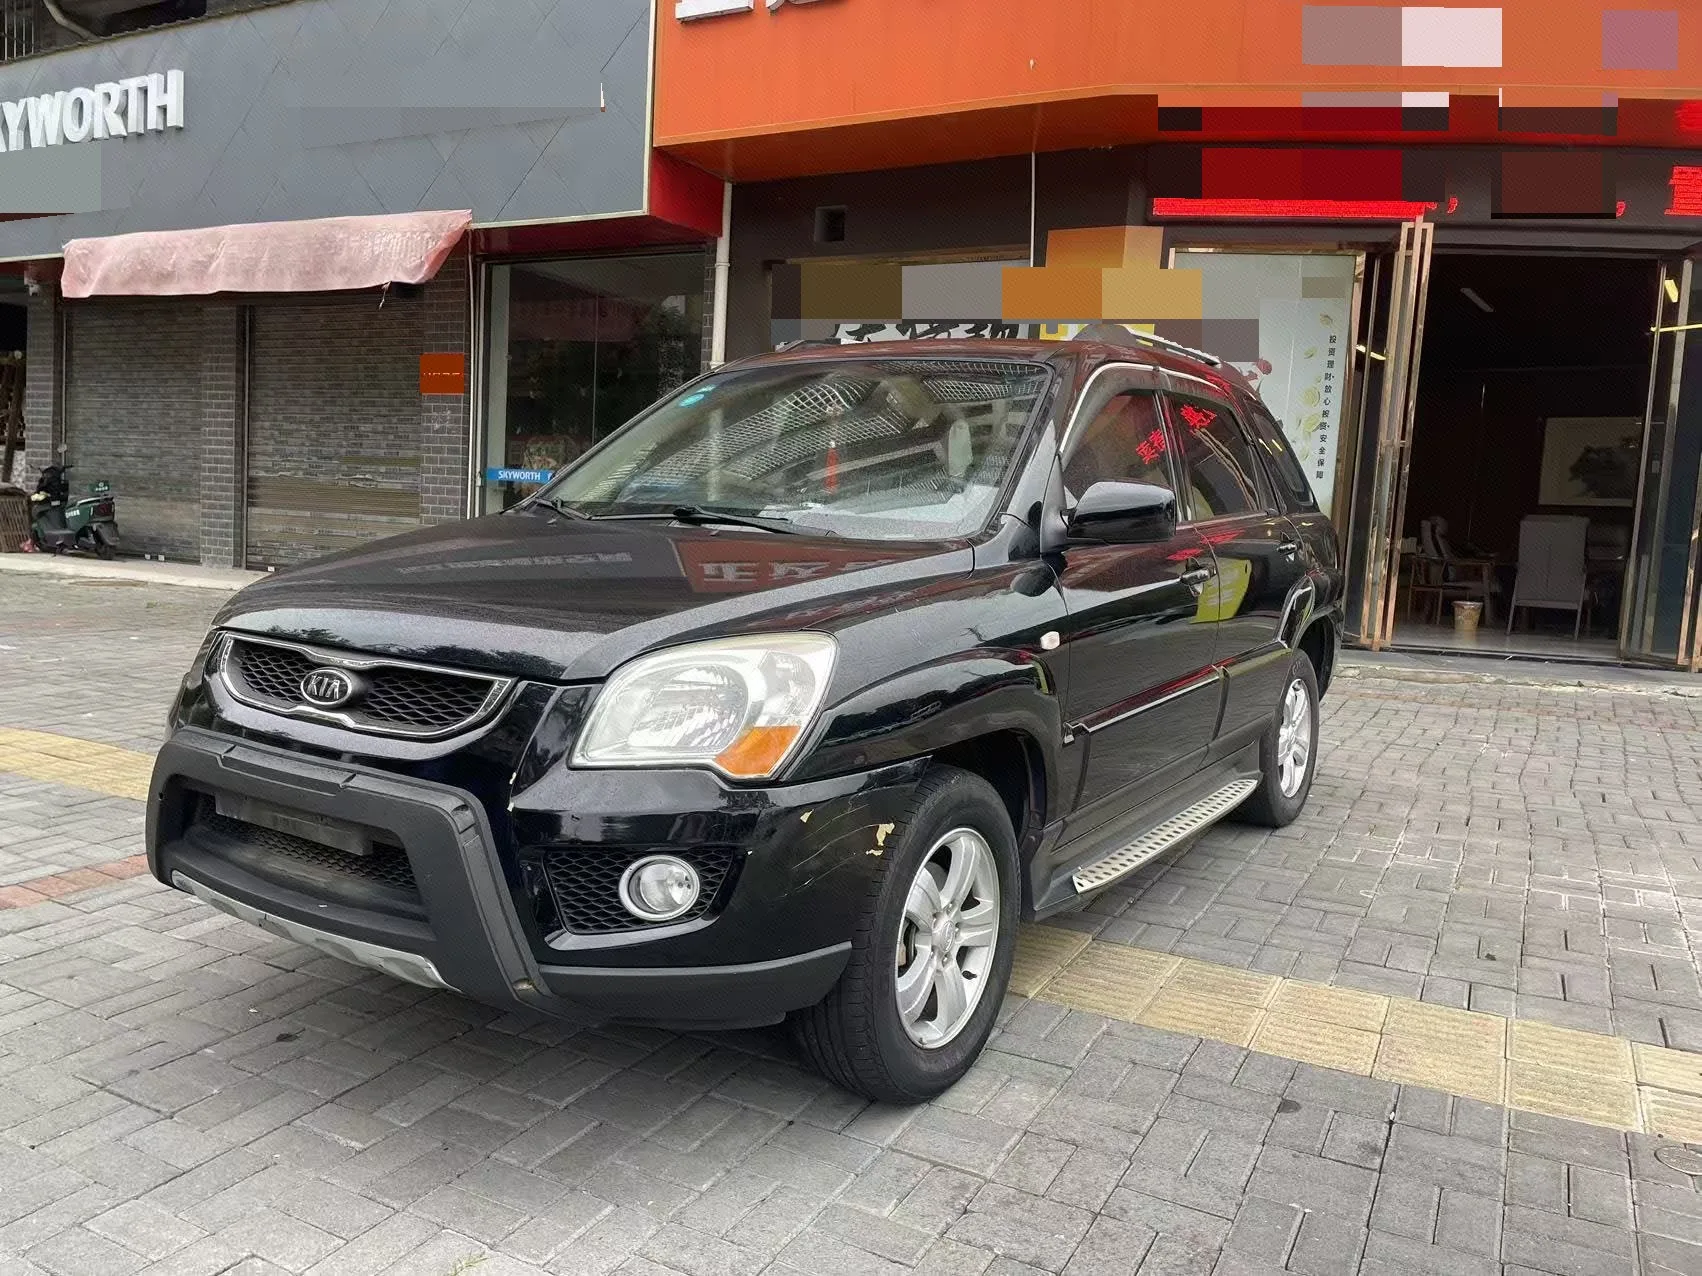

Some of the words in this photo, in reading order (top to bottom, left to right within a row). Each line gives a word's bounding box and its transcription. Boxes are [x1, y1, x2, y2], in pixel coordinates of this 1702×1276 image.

[0, 70, 184, 151] YWORTH
[498, 470, 541, 481] SKYWORTH
[306, 675, 341, 700] KIA
